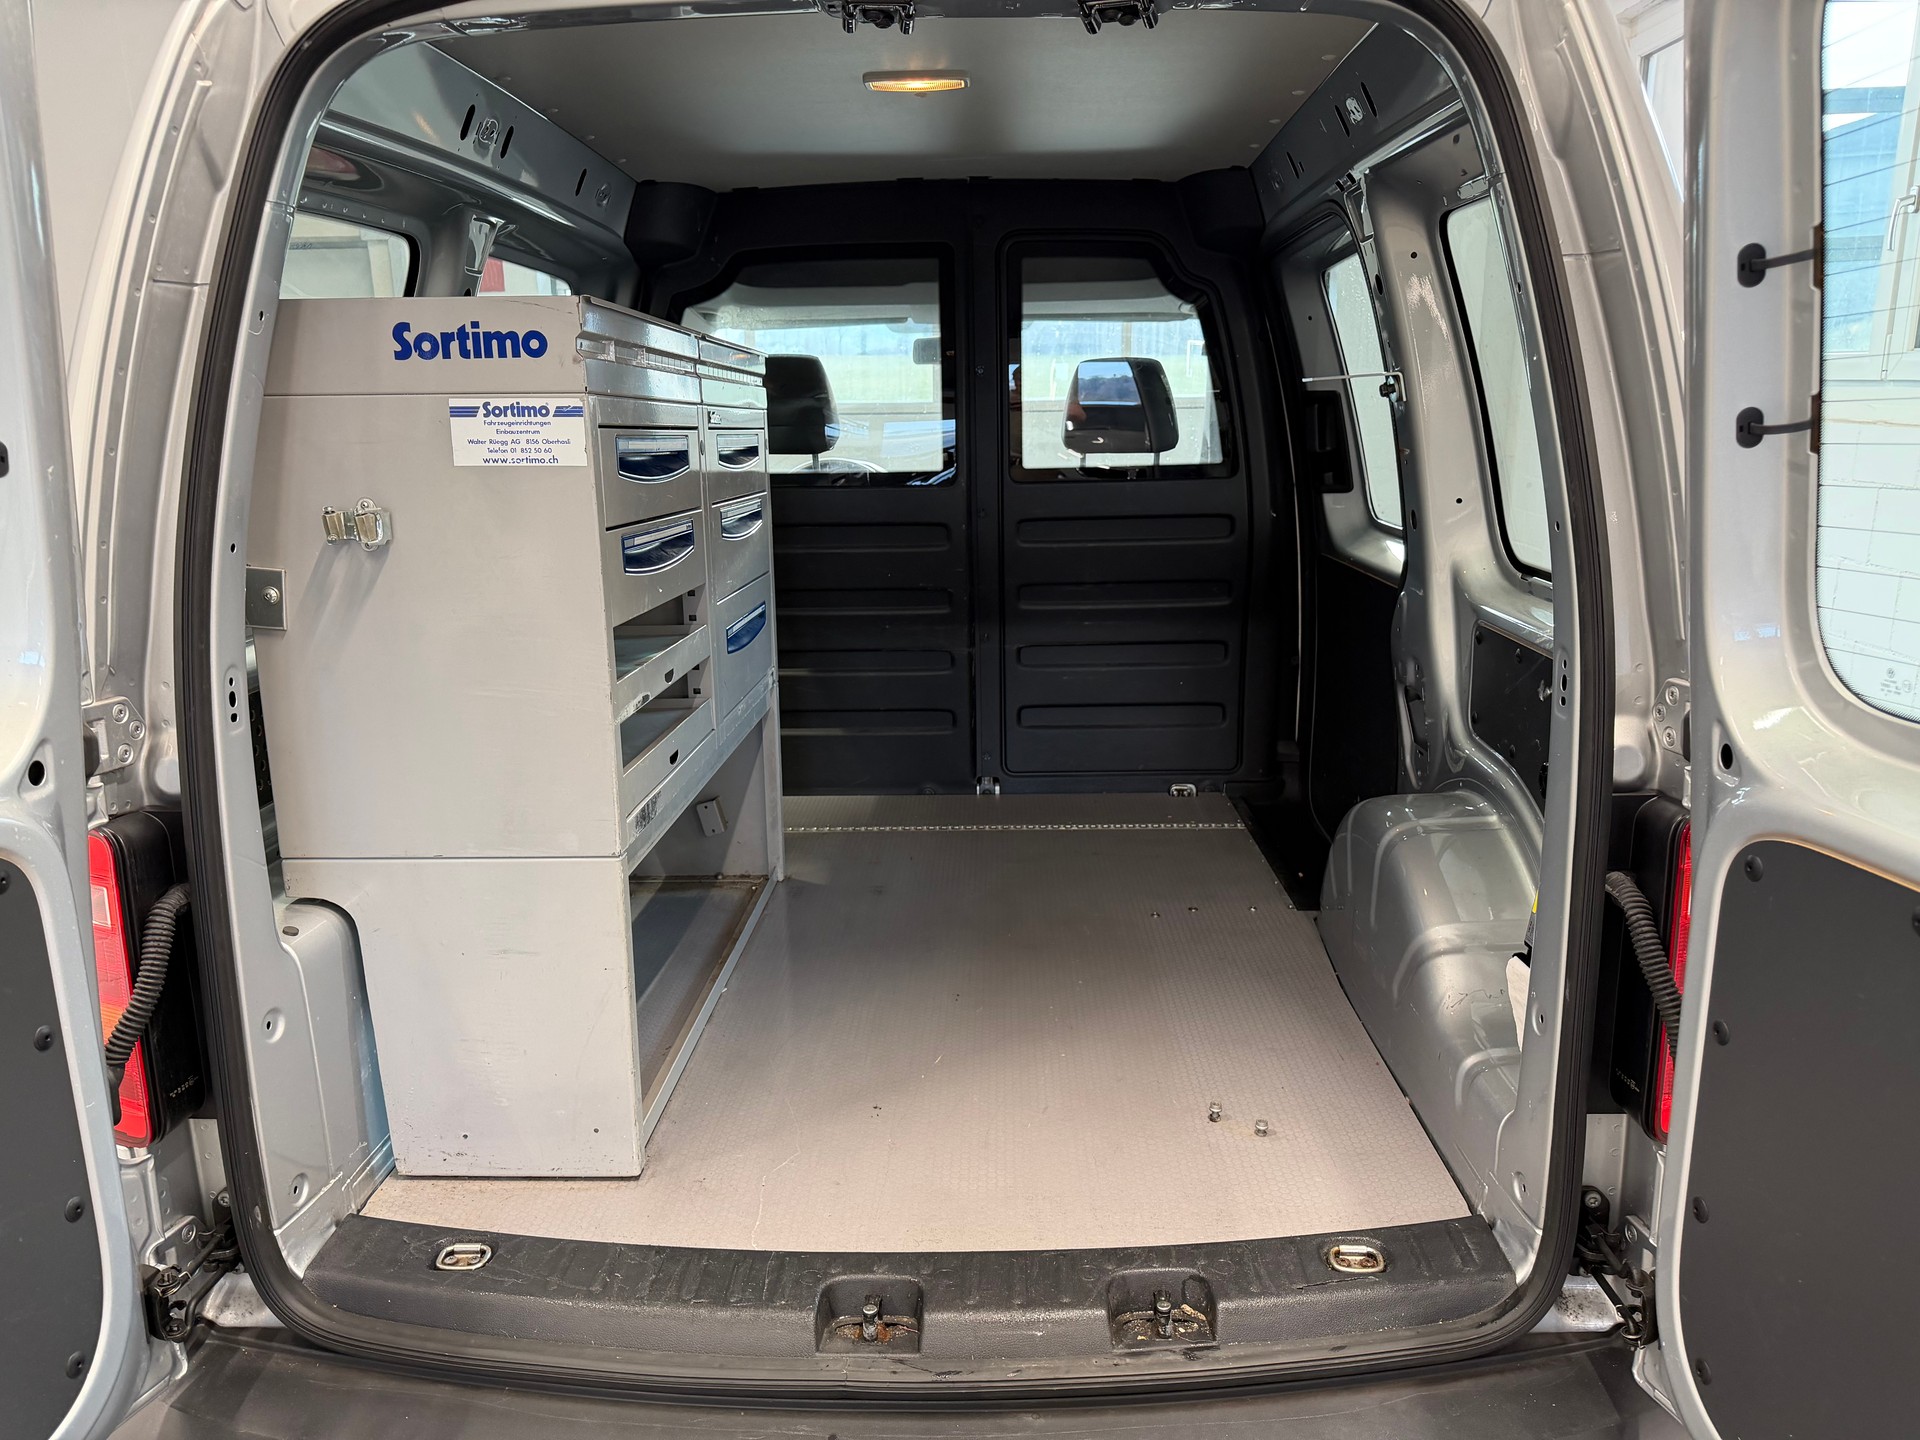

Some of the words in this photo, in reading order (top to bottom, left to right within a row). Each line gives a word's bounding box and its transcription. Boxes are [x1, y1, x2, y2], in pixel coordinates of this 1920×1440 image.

[392, 321, 548, 360] Sortimo
[482, 401, 550, 418] Sortimo
[483, 419, 551, 427] Fahrzeugeinrichtungen
[489, 438, 509, 447] Rüegg
[487, 446, 509, 454] Telefon
[482, 454, 559, 464] www.sortimo.ch
